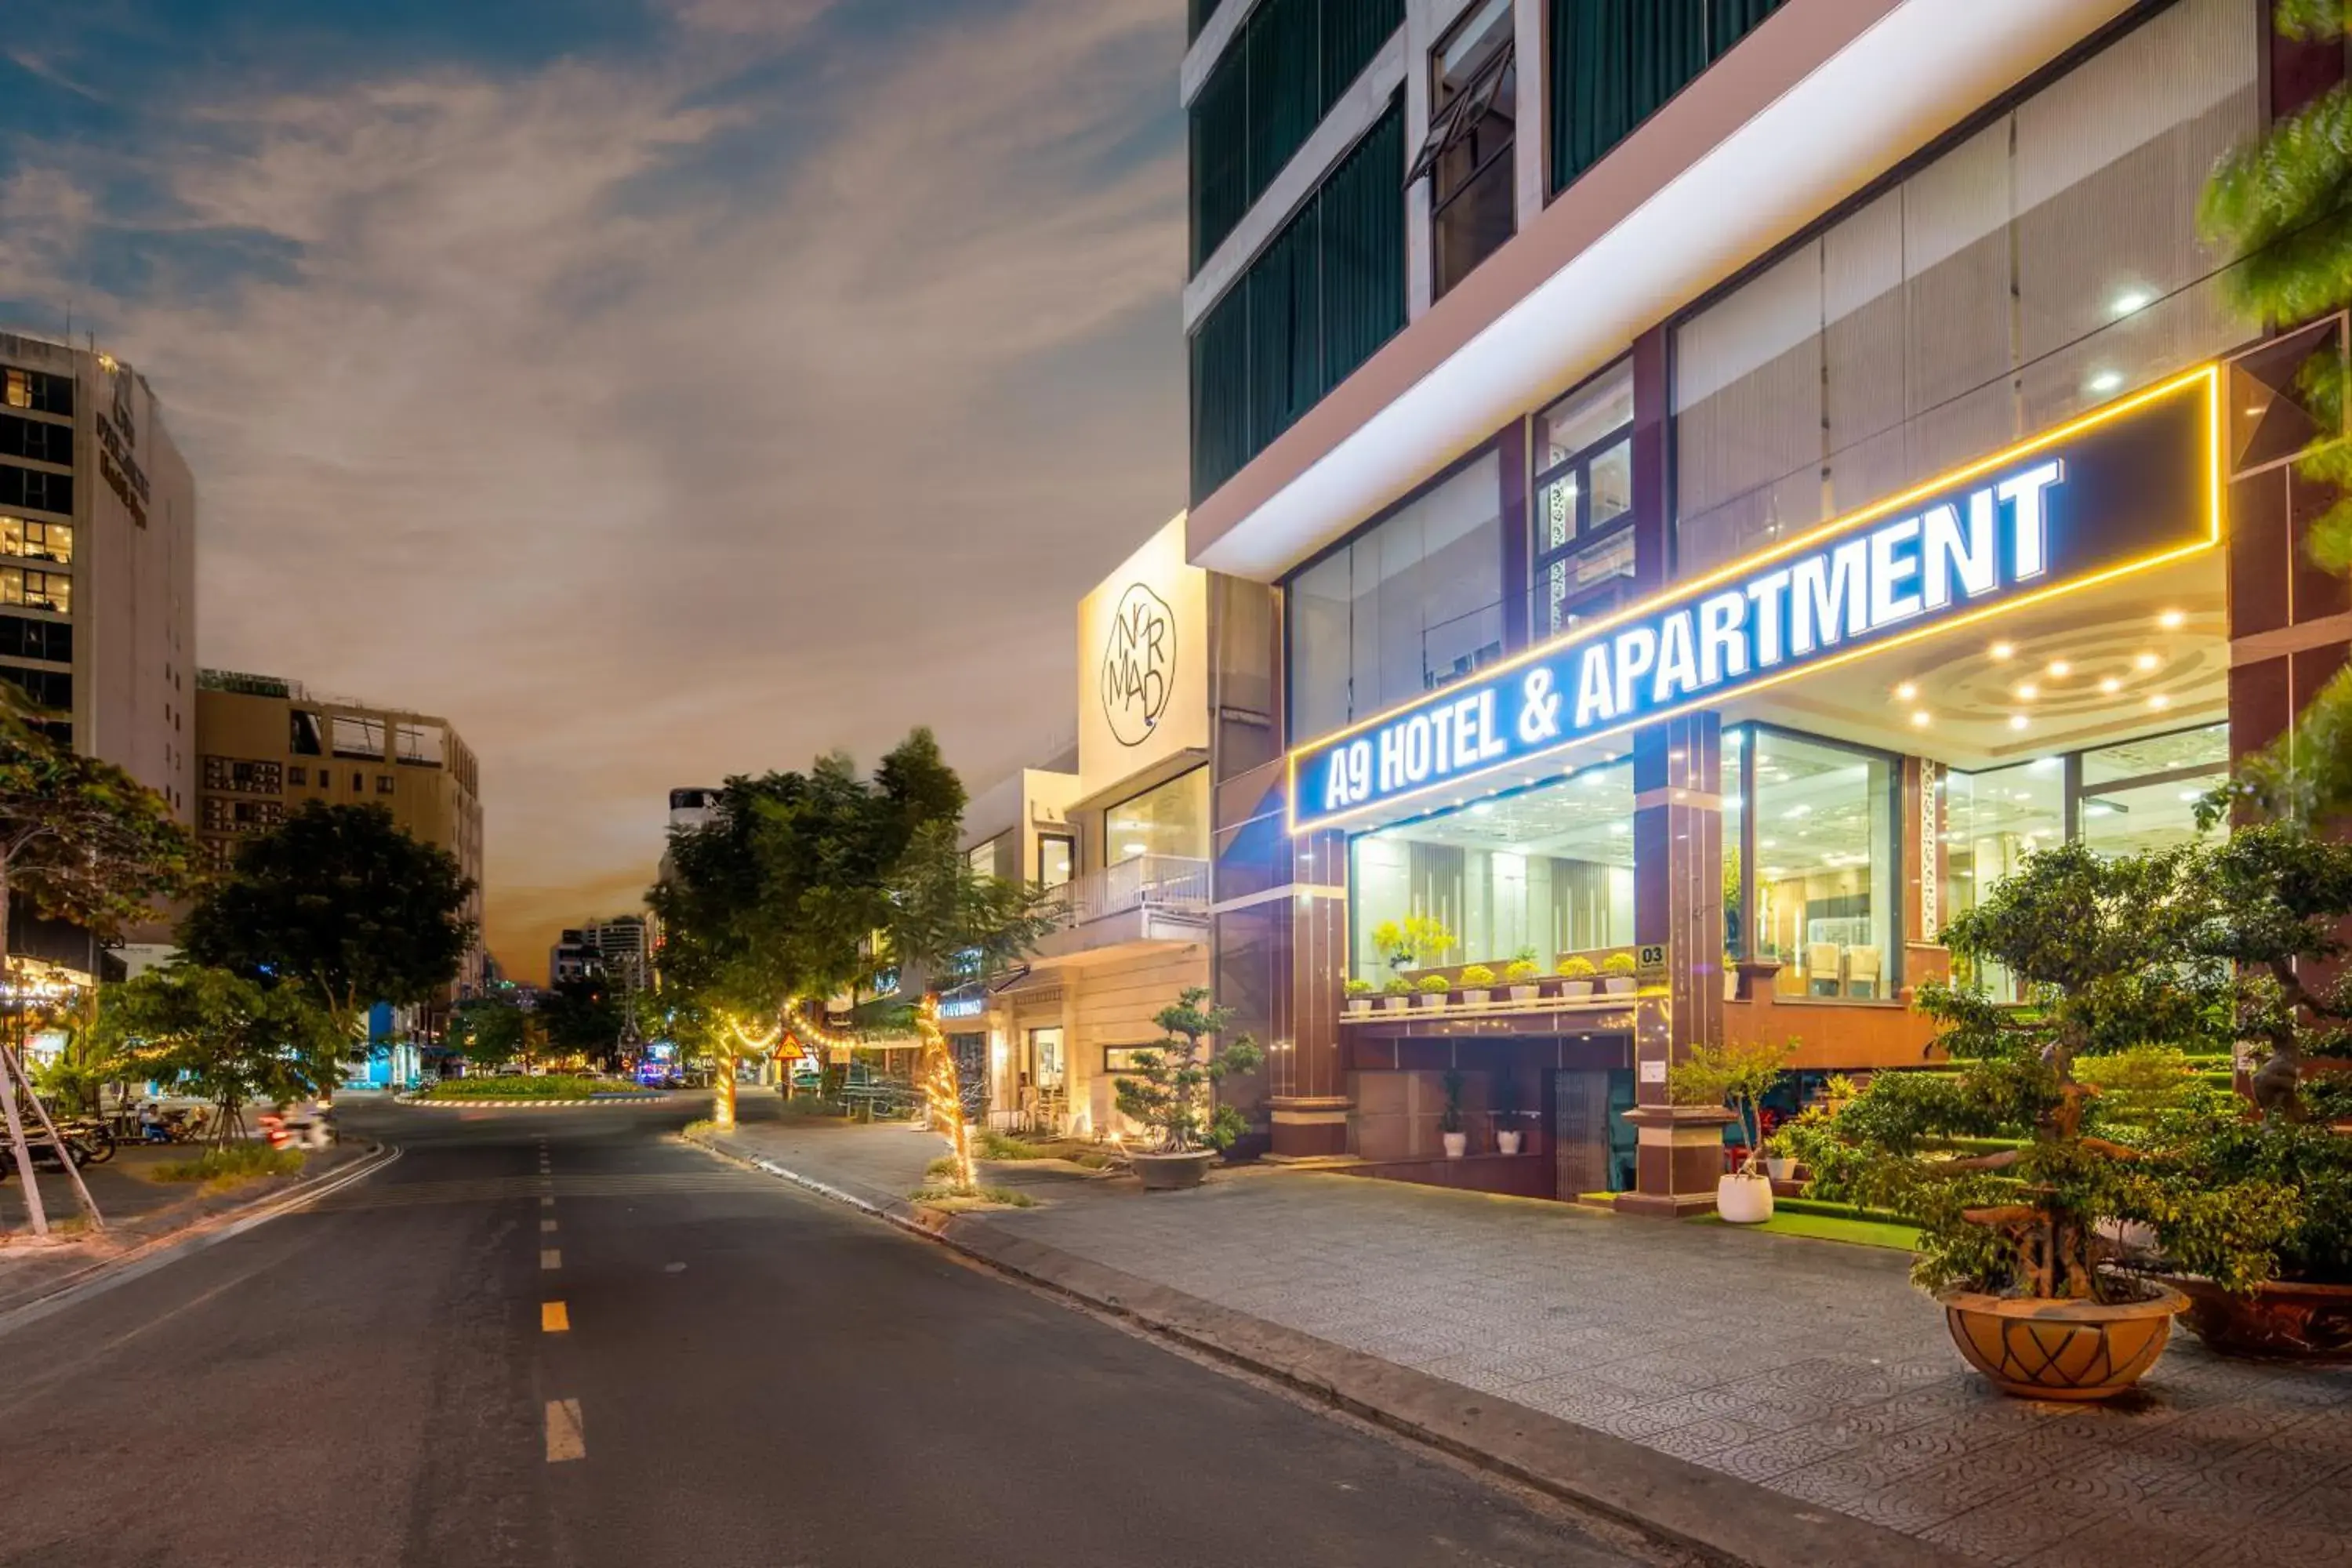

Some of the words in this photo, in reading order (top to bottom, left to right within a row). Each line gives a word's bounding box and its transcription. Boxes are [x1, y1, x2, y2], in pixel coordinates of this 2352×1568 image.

[1325, 737, 1374, 809] A9
[1379, 688, 1507, 792] HOTEL
[1518, 667, 1561, 744] &
[1574, 457, 2065, 728] APARTMENT
[1109, 648, 1163, 720] MAD
[1642, 947, 1663, 963] 03
